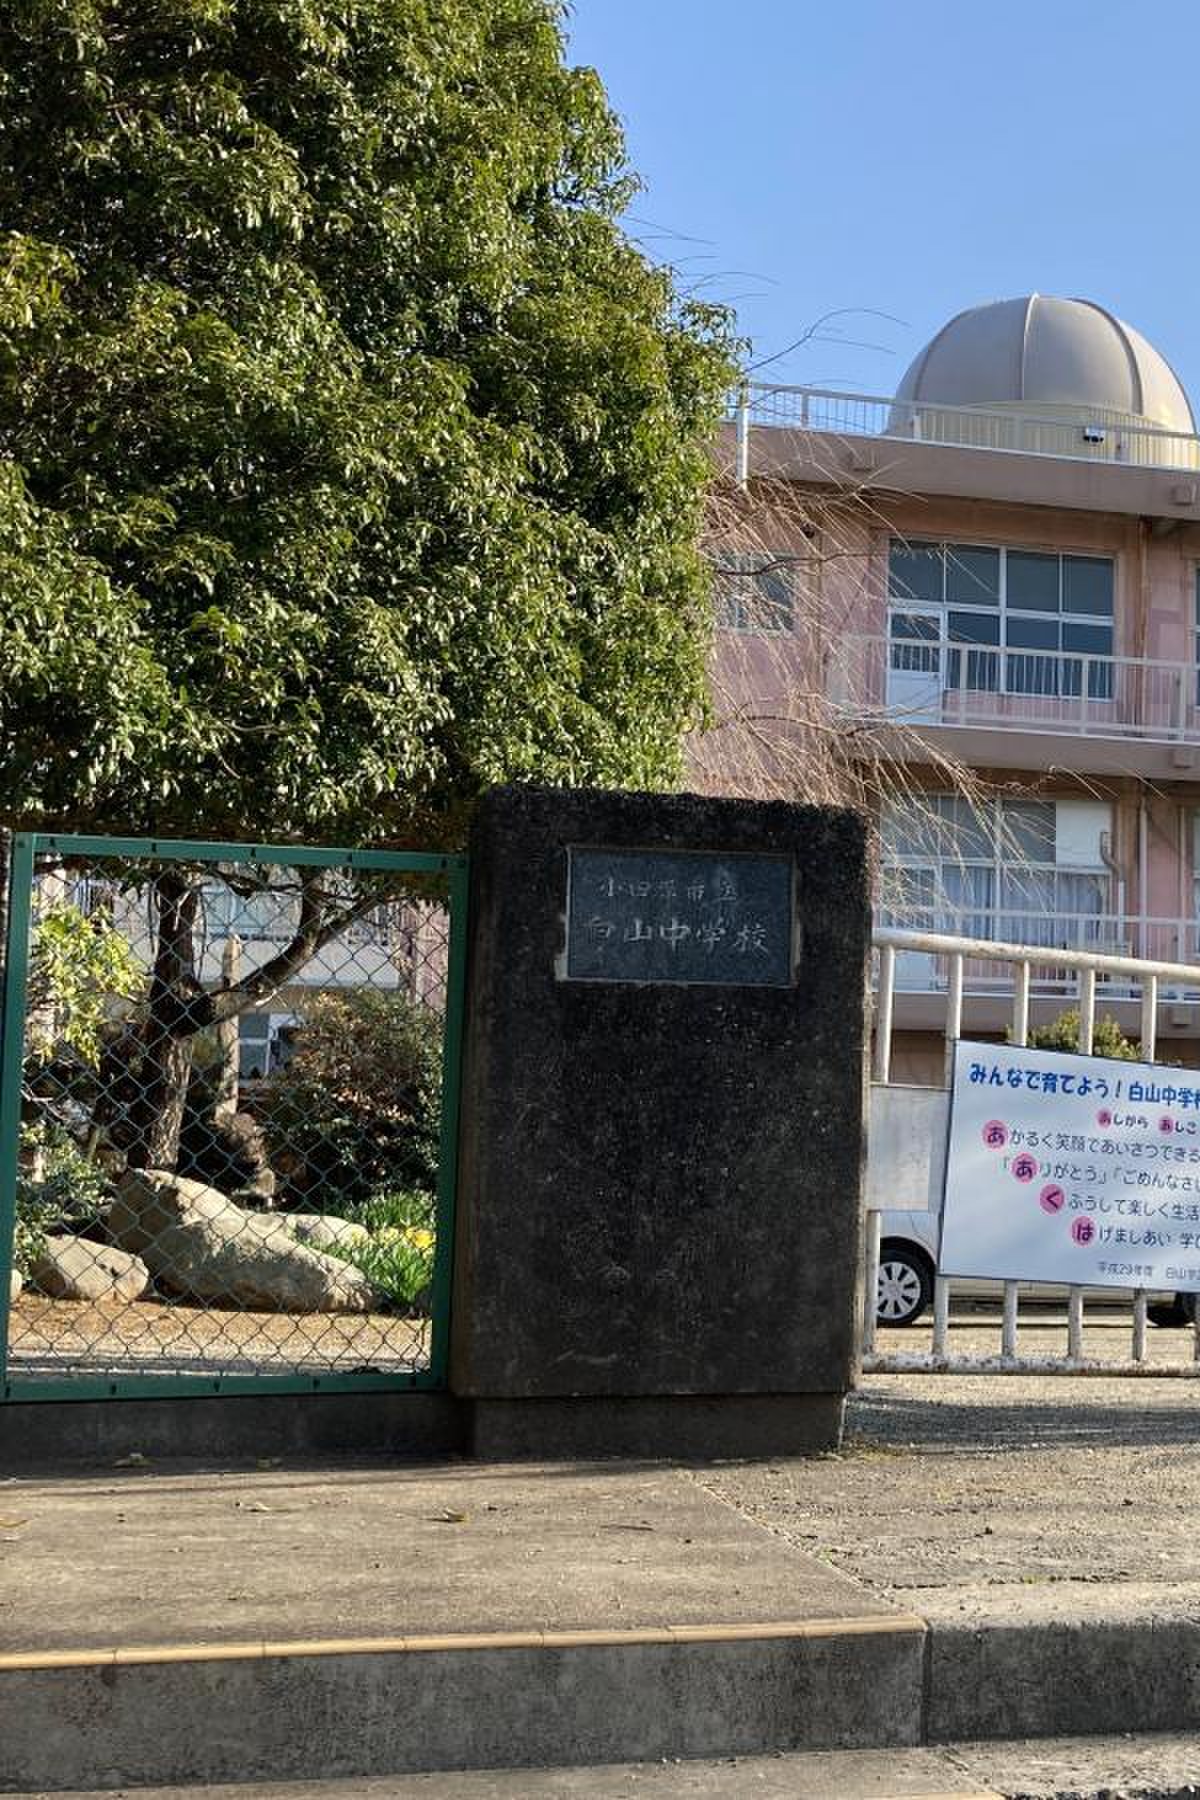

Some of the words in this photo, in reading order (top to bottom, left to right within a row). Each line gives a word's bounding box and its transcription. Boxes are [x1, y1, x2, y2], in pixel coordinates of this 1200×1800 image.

[584, 914, 769, 957] 白山中学校
